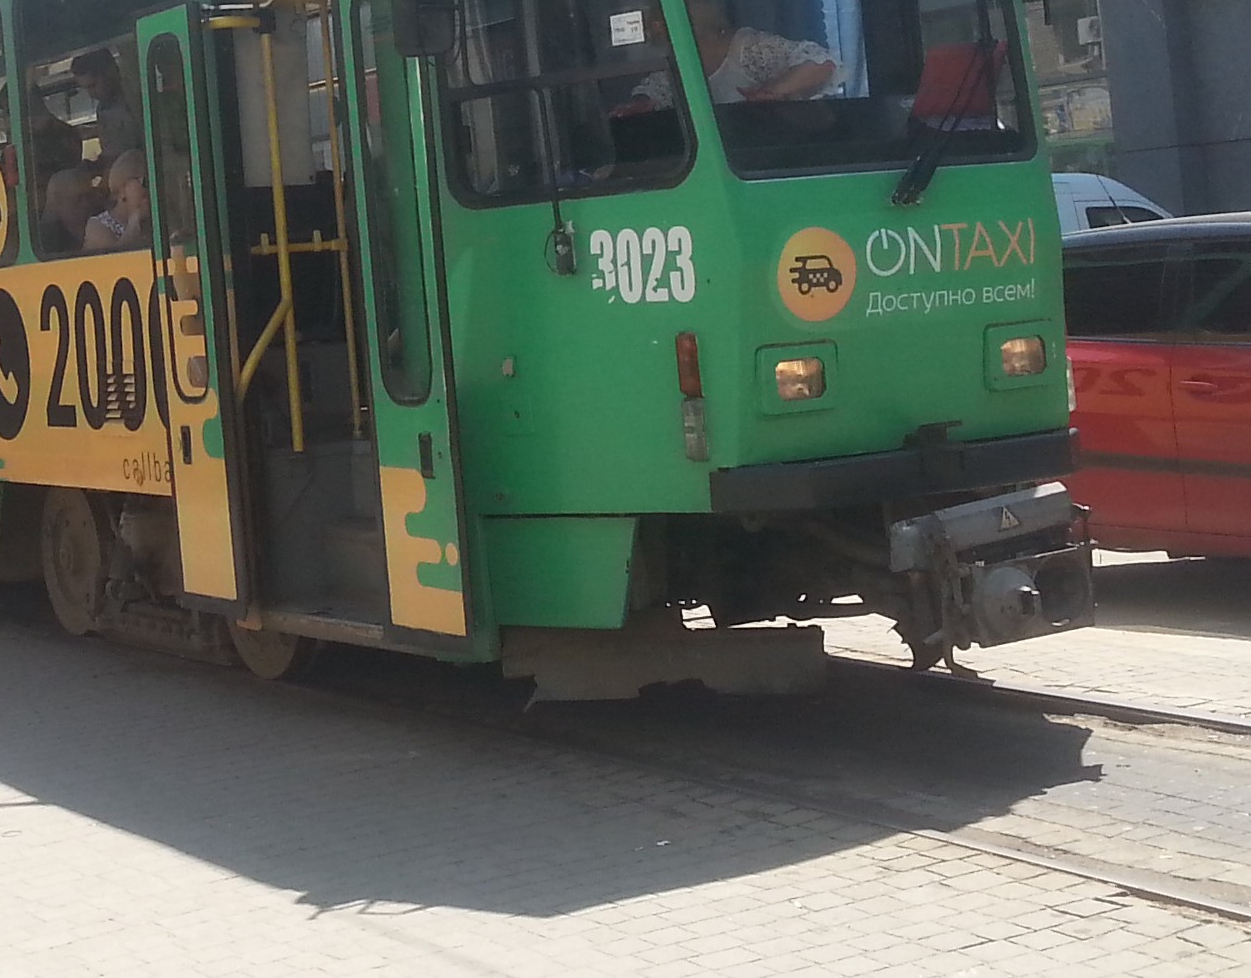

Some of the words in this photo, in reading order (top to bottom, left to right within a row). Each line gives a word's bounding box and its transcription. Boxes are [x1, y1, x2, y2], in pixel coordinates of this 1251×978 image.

[589, 225, 696, 304] 3023
[865, 217, 1036, 278] ONTAXI
[865, 284, 978, 319] Доступно
[981, 283, 1036, 306] всем!
